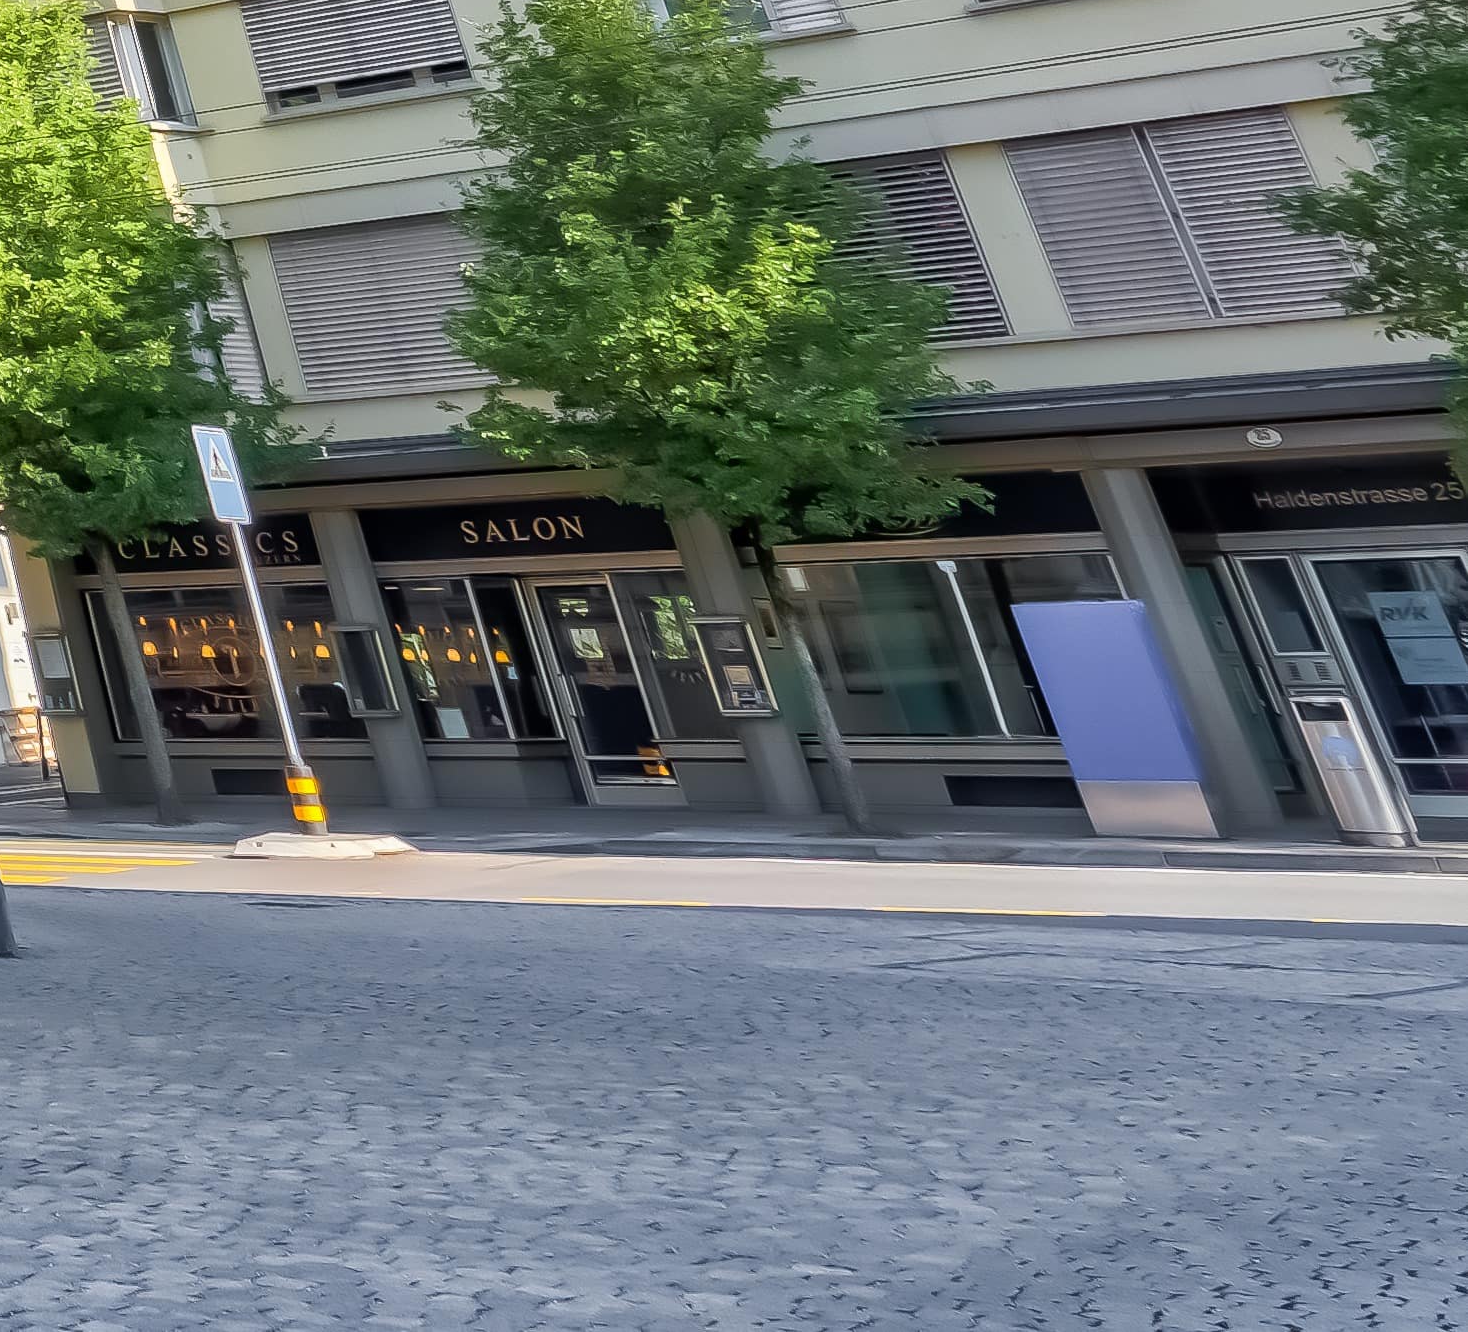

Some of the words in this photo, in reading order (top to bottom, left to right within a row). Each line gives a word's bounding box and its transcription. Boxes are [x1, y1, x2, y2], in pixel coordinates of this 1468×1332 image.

[1253, 487, 1428, 509] Haldenstrasse
[1431, 482, 1465, 501] 25
[460, 516, 584, 543] SALON
[118, 531, 299, 559] CLASSCS
[1379, 601, 1430, 621] RVK
